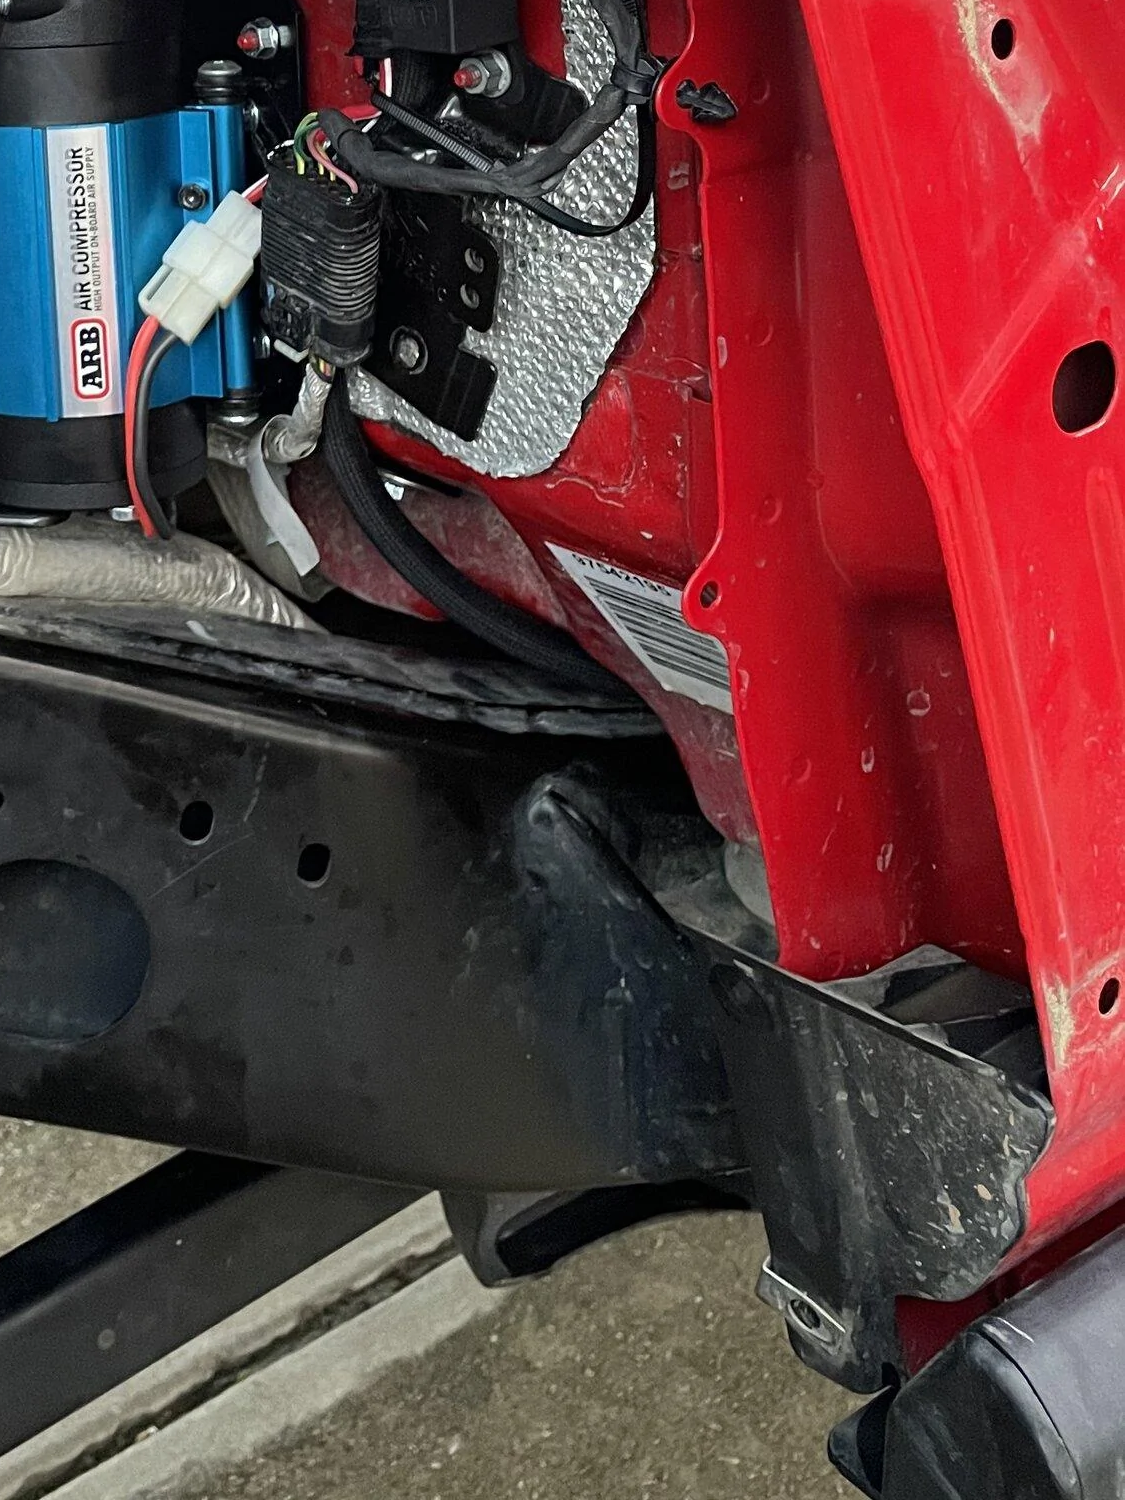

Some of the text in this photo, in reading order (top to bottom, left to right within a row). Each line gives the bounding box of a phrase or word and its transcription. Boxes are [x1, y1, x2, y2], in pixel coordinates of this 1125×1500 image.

[64, 147, 93, 311] AIR COMPRESSOR
[84, 146, 103, 311] HIGH OUTPUT ON-BOARD AIR SUPPLY
[79, 326, 103, 389] ARB
